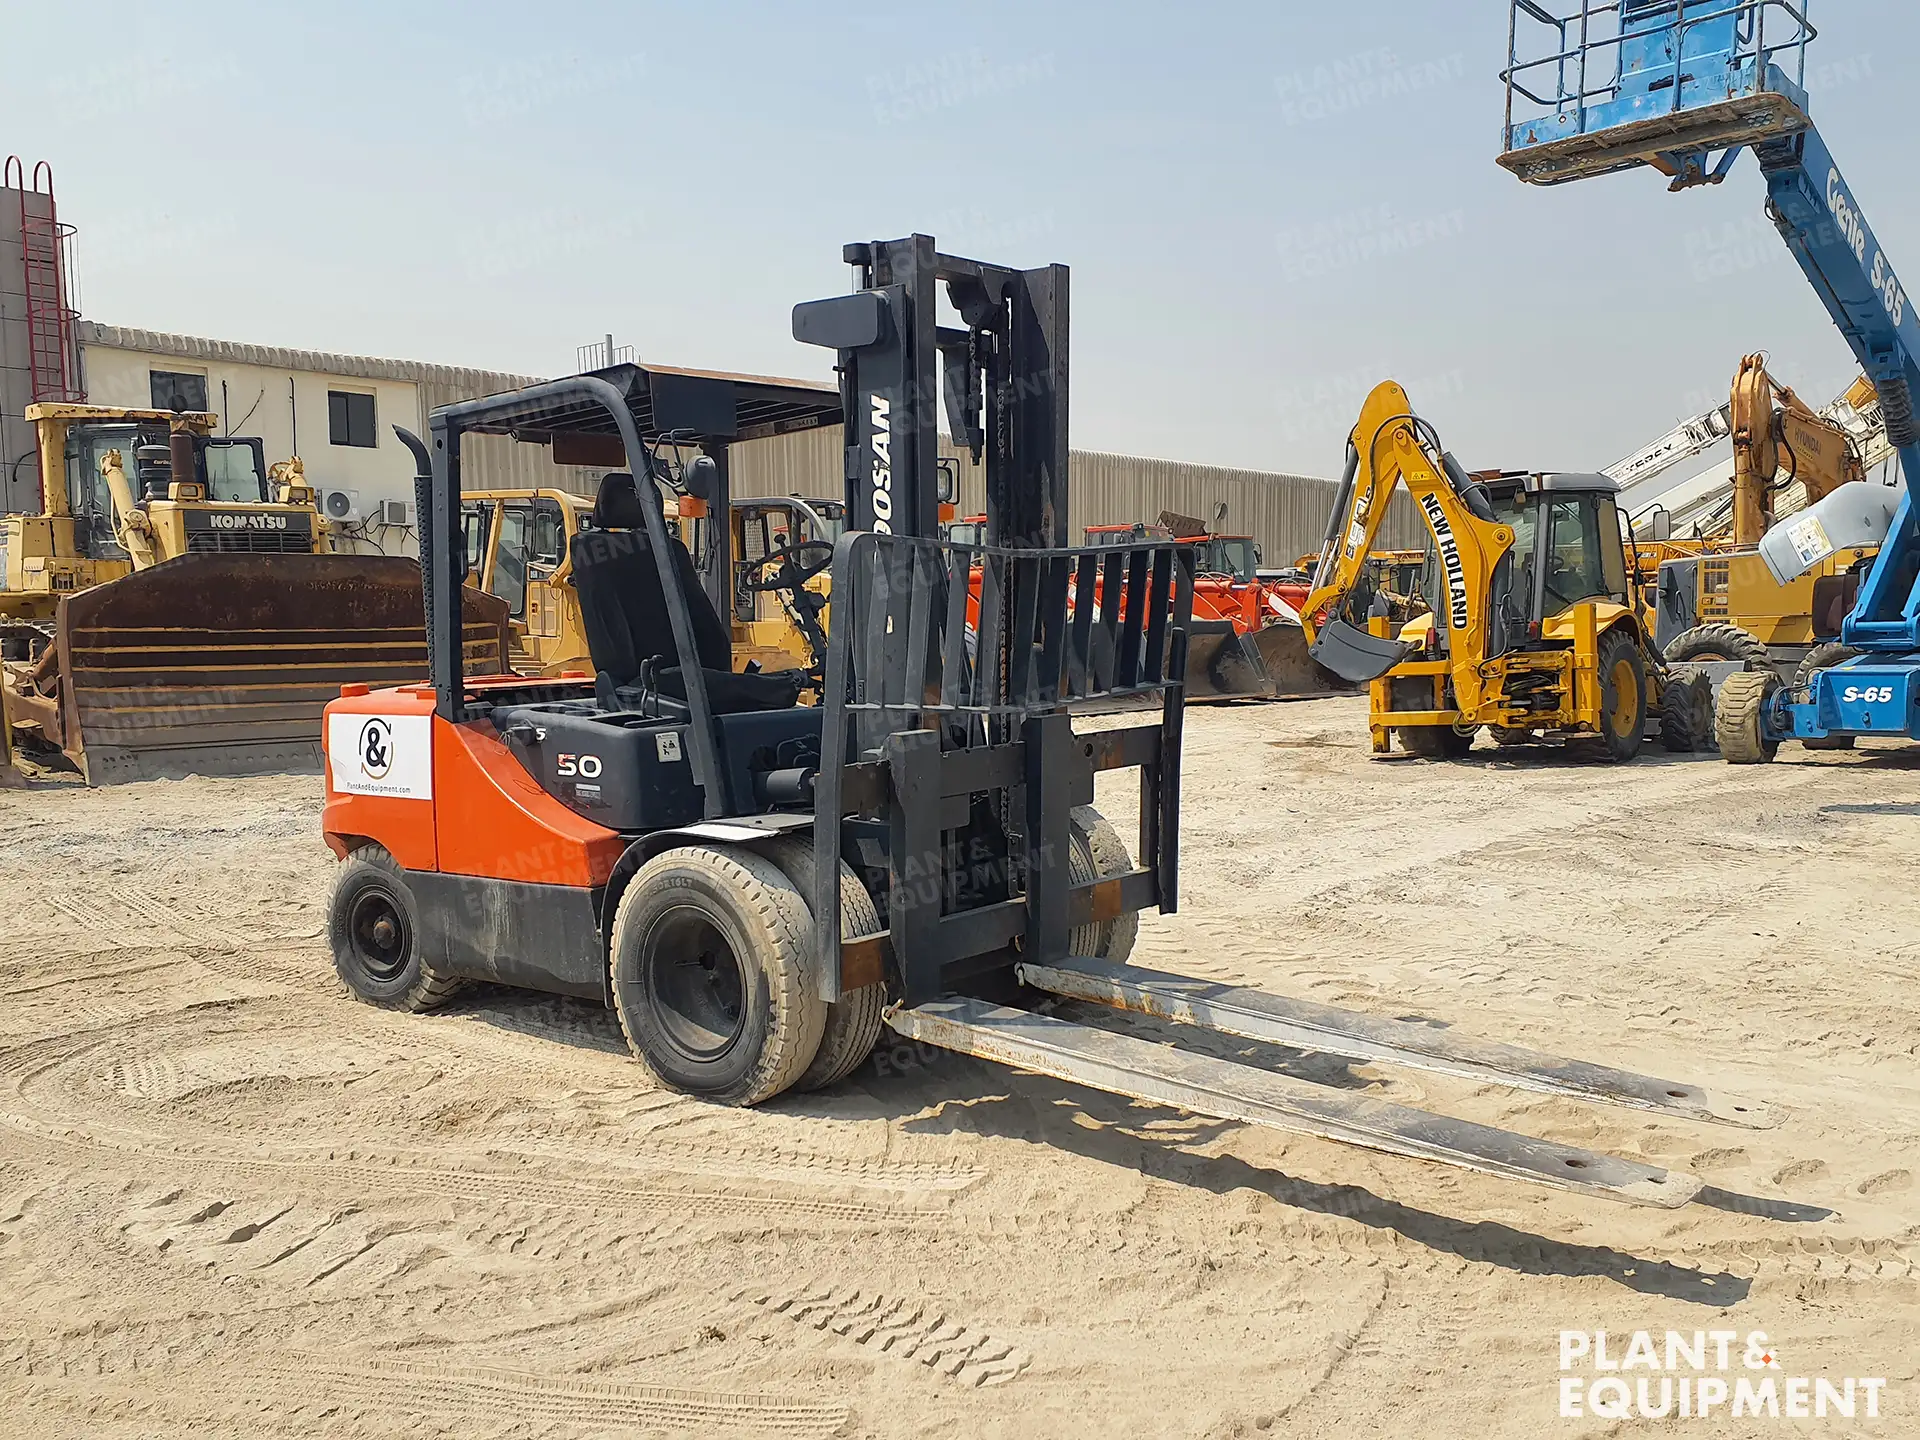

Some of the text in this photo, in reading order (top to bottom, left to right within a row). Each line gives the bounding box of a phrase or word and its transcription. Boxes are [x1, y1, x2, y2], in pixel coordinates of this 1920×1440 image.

[1826, 168, 1905, 327] Genie S-65
[210, 513, 287, 529] KOMATSU
[1421, 492, 1468, 629] NEW HOLLAND
[1842, 686, 1893, 703] S-65
[557, 753, 603, 778] 50
